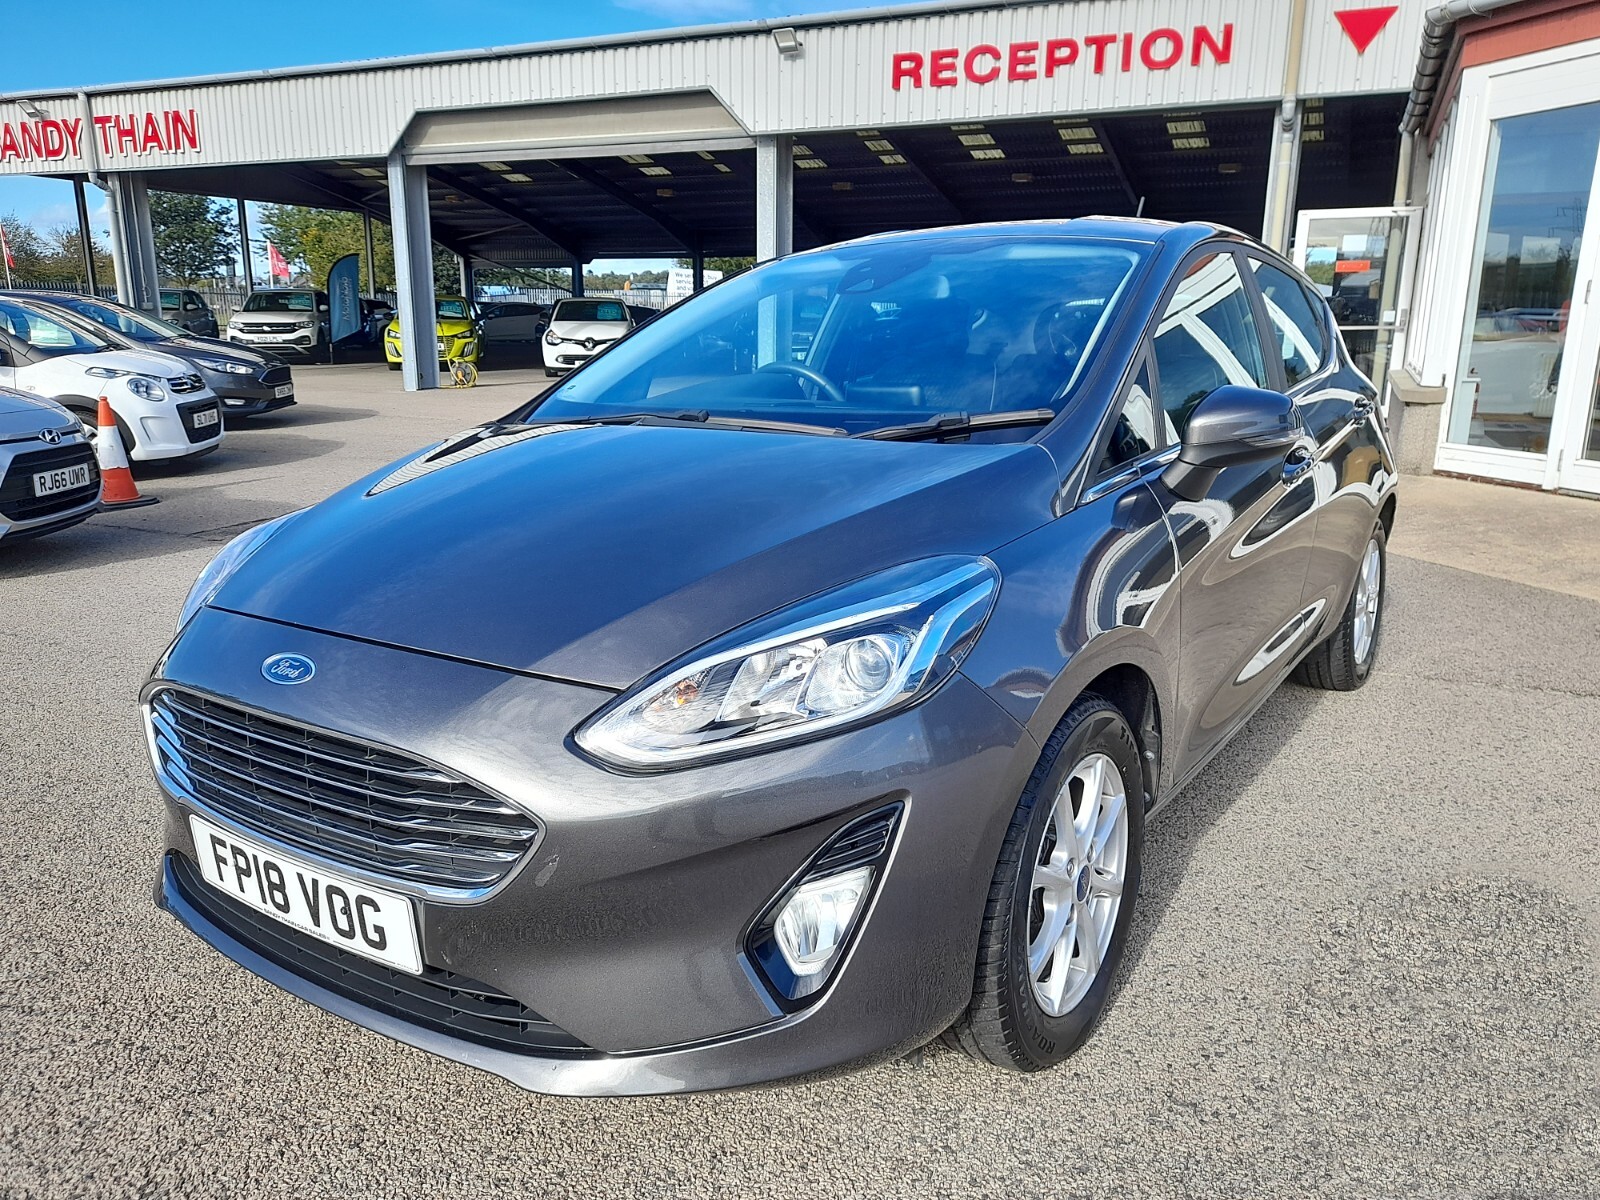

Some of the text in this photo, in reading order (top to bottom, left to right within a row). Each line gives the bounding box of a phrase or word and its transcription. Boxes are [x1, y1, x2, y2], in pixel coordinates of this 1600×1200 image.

[891, 23, 1234, 90] RECEPTION
[0, 109, 198, 161] ANDY THAIN
[39, 467, 87, 493] RJ66 UWR
[270, 658, 304, 678] Ford
[209, 833, 388, 952] FP18 VOG
